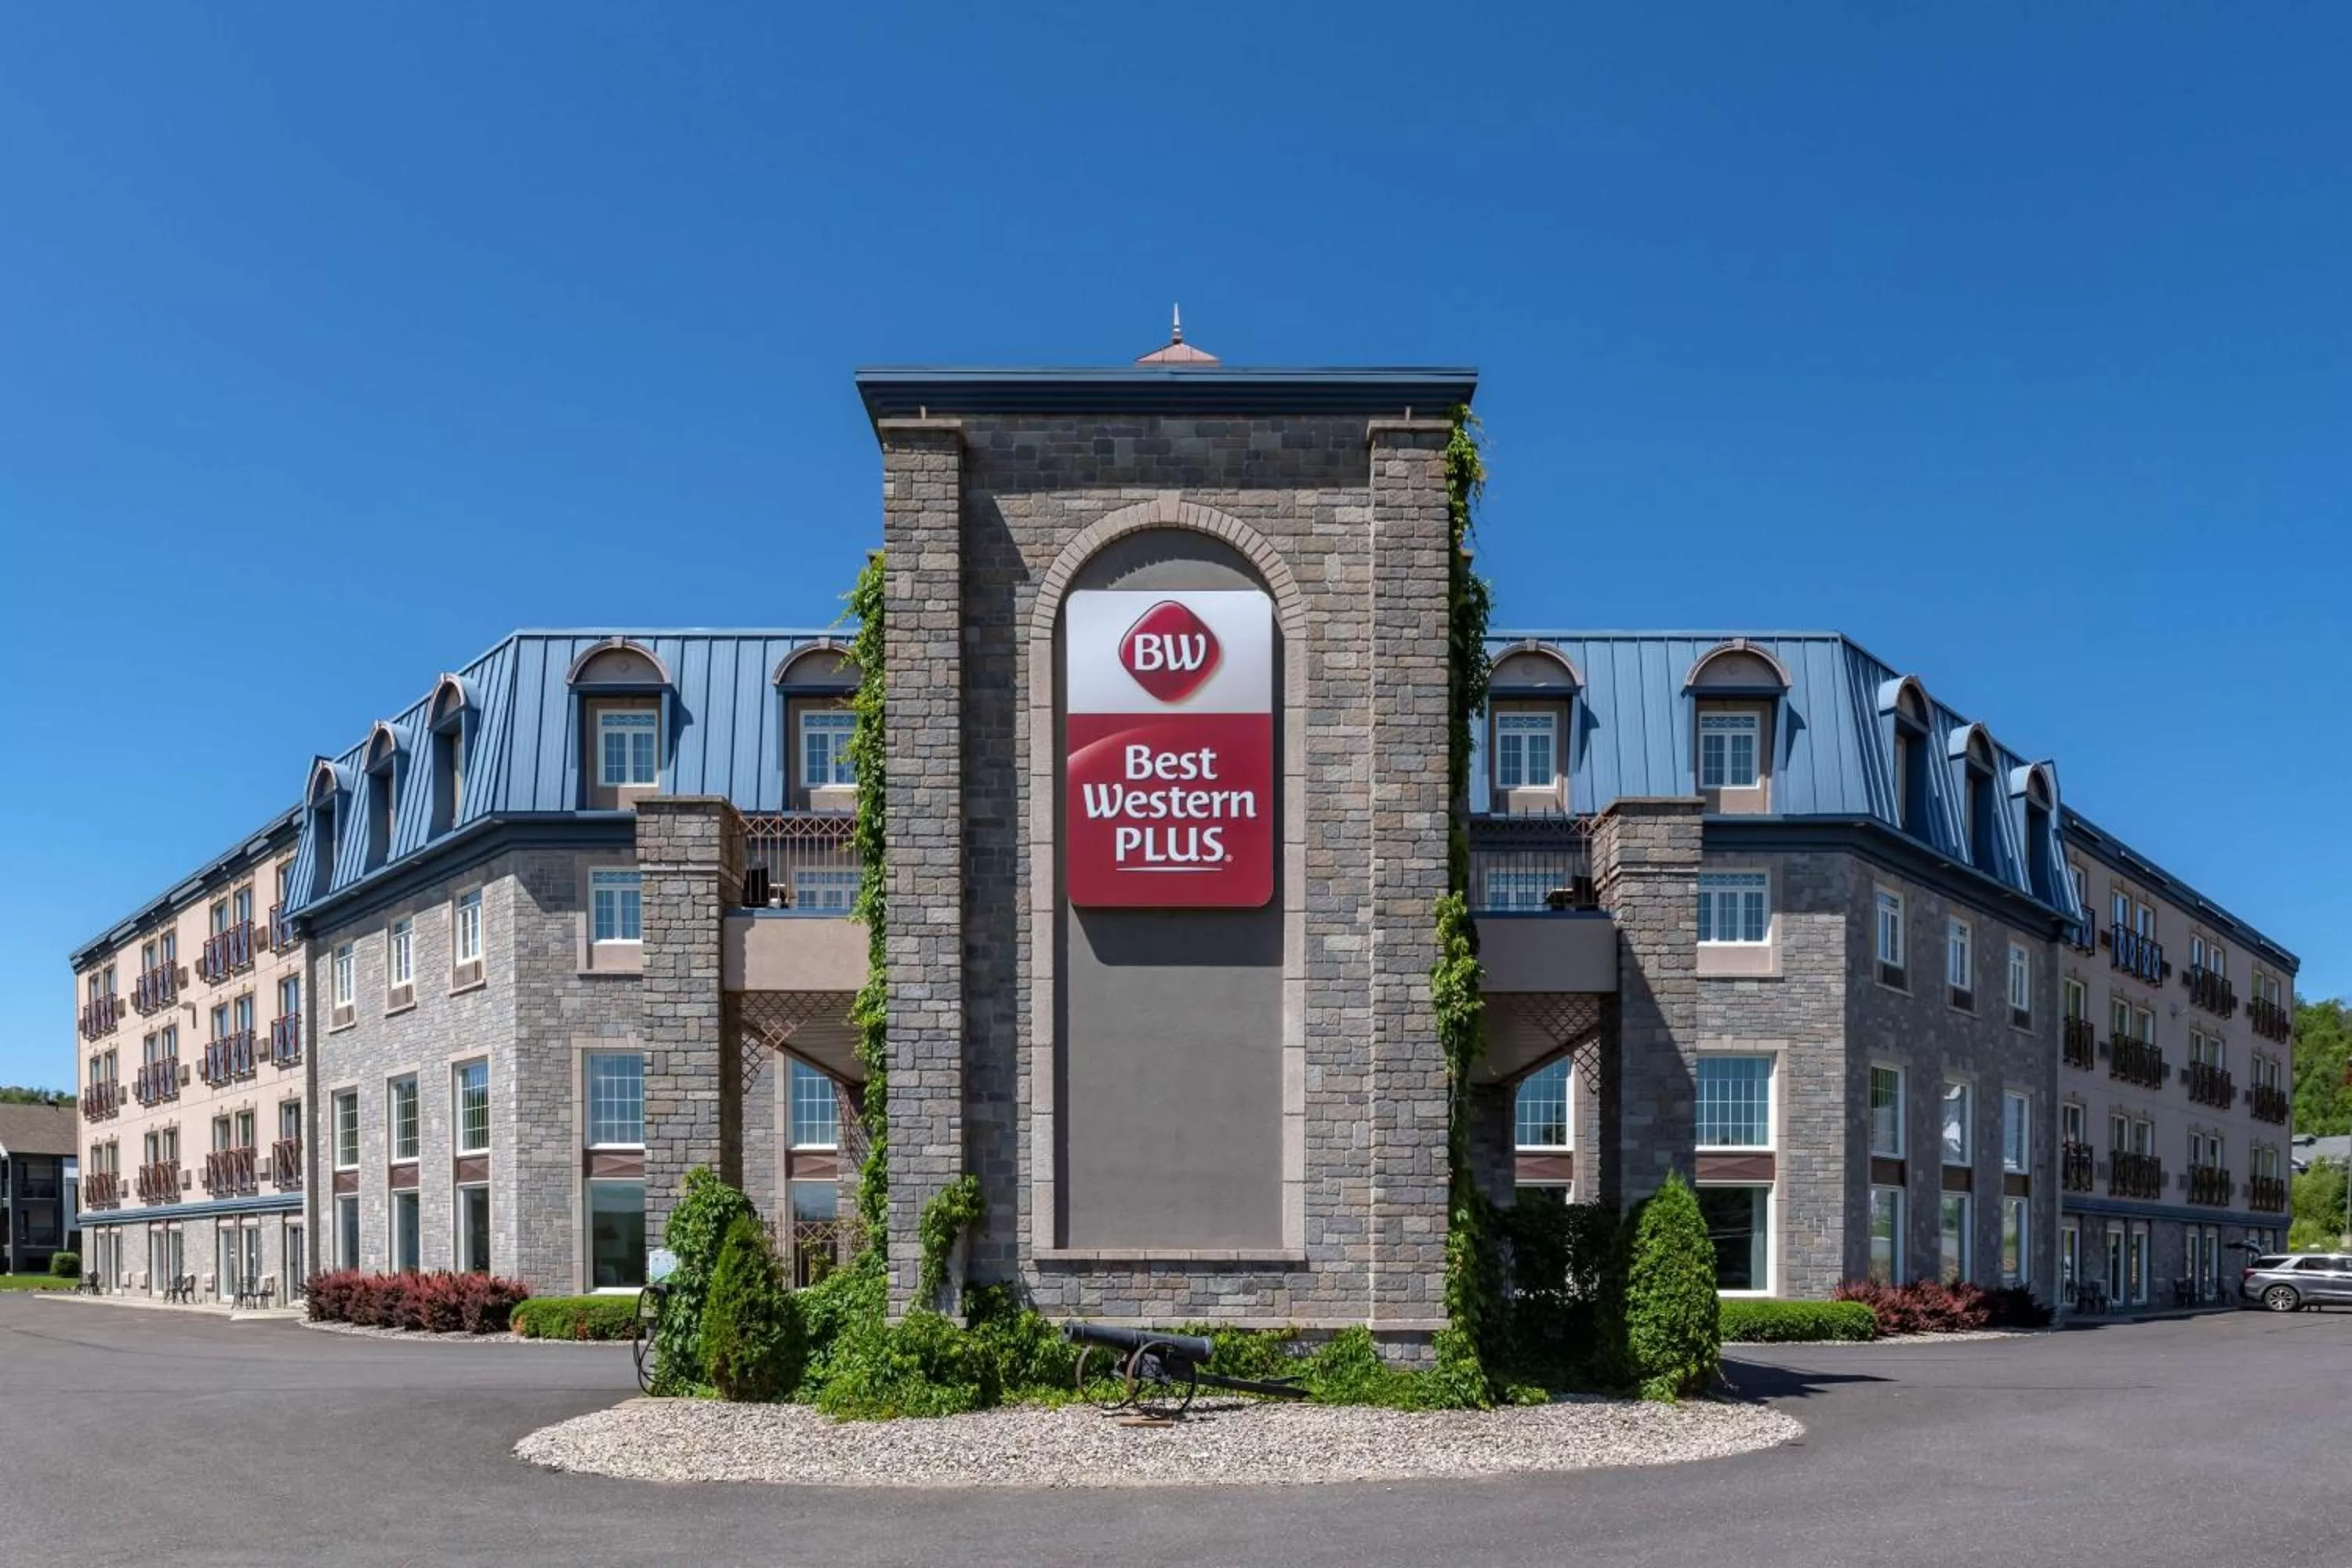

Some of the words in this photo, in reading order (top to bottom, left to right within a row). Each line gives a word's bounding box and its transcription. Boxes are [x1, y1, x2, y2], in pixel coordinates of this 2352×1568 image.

[1134, 633, 1207, 671] BW
[1125, 744, 1218, 780] Best
[1083, 783, 1257, 818] Western
[1116, 827, 1225, 862] PLUS
